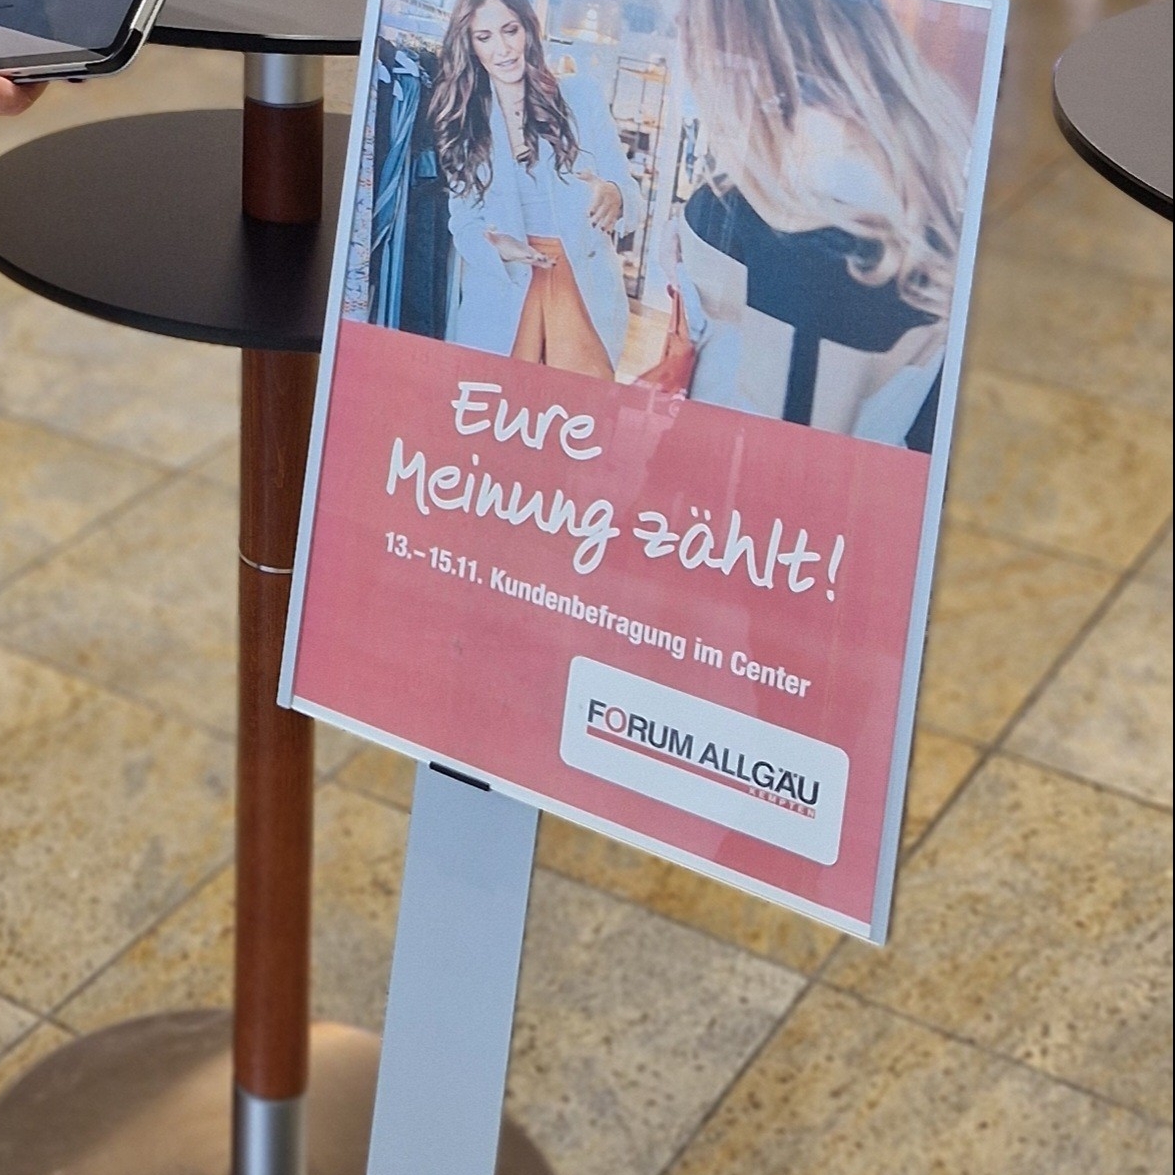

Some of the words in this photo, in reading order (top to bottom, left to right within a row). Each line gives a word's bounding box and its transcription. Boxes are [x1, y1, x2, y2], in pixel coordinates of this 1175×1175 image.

[451, 380, 603, 461] Eure
[385, 436, 621, 576] Meinung
[632, 506, 845, 602] zählt!
[490, 566, 687, 660] Kundenbefragung
[693, 637, 723, 669] im
[730, 650, 812, 698] Center
[587, 698, 694, 760] FORUM
[698, 742, 820, 806] ALLGÄU
[748, 787, 816, 820] KEMPTEN
